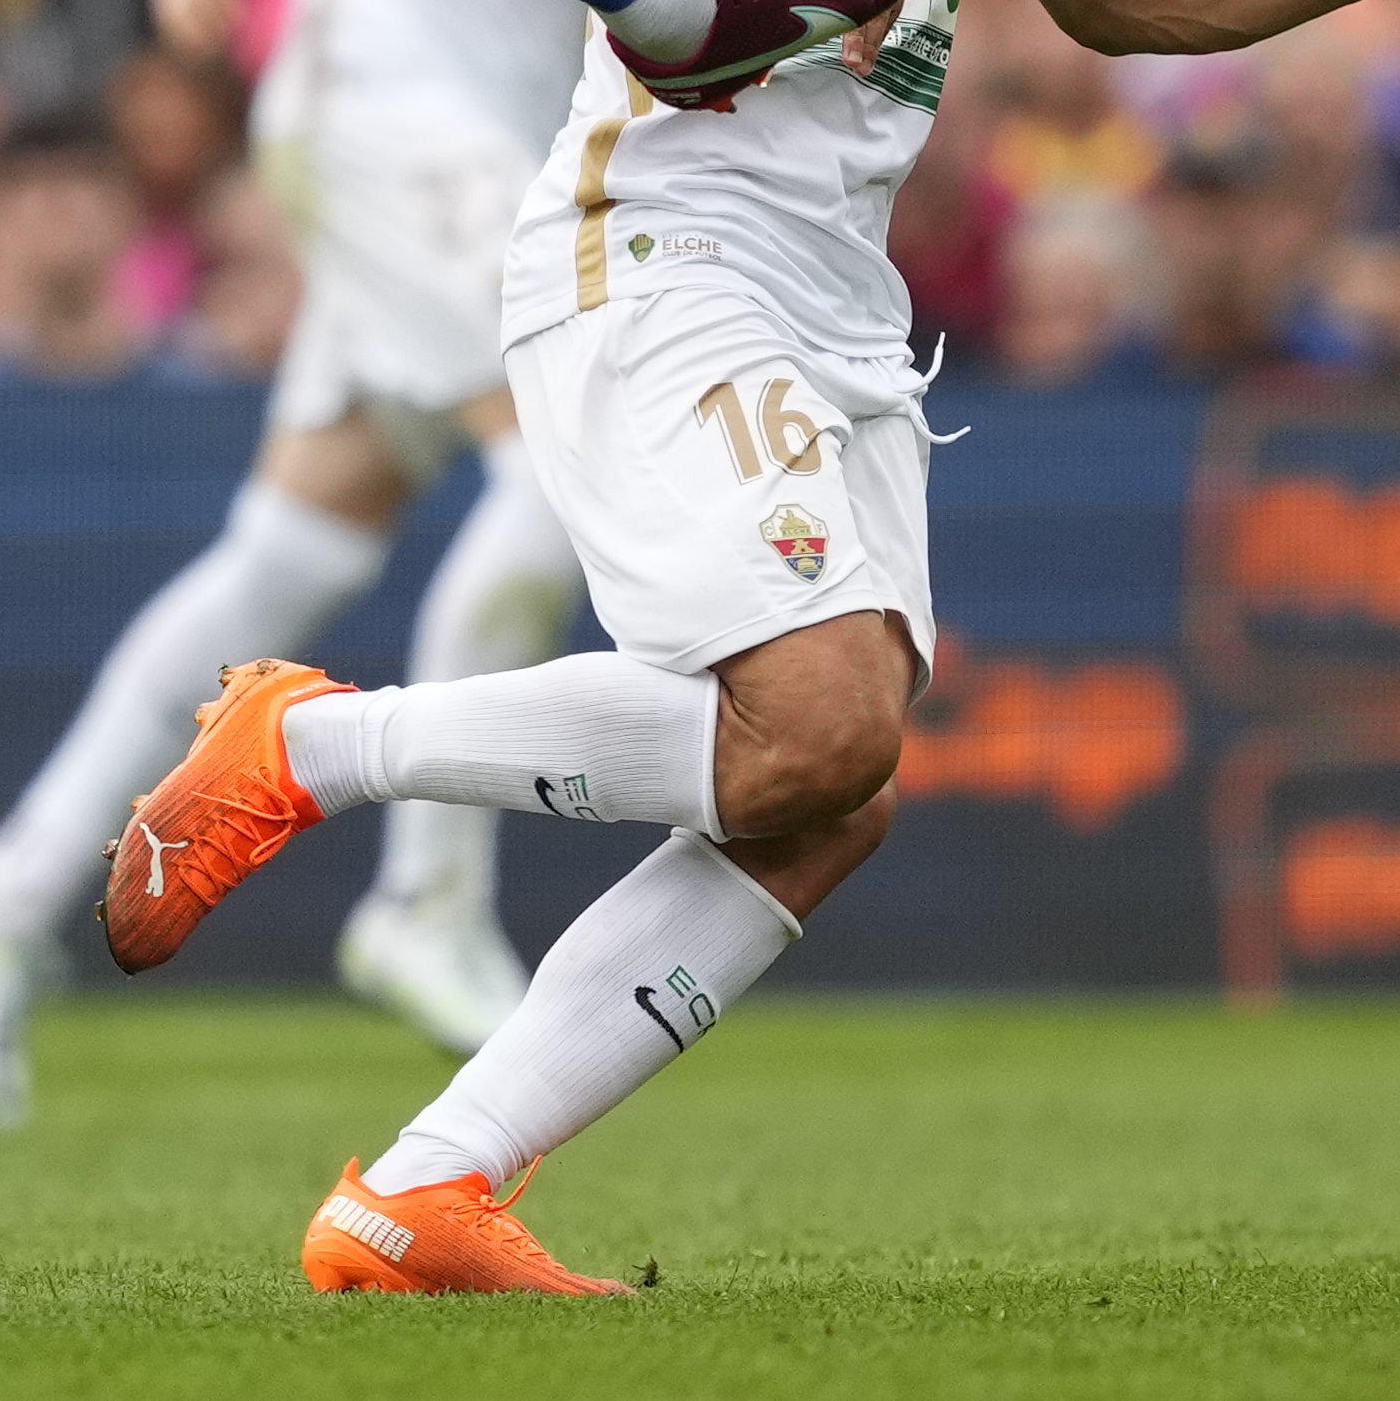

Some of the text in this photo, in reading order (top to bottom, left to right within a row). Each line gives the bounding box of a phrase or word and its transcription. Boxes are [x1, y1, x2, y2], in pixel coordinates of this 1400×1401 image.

[882, 25, 902, 48] al
[930, 40, 949, 65] Gro
[662, 237, 723, 255] ELCHE
[693, 377, 822, 486] 16
[317, 1194, 416, 1263] PUMA
